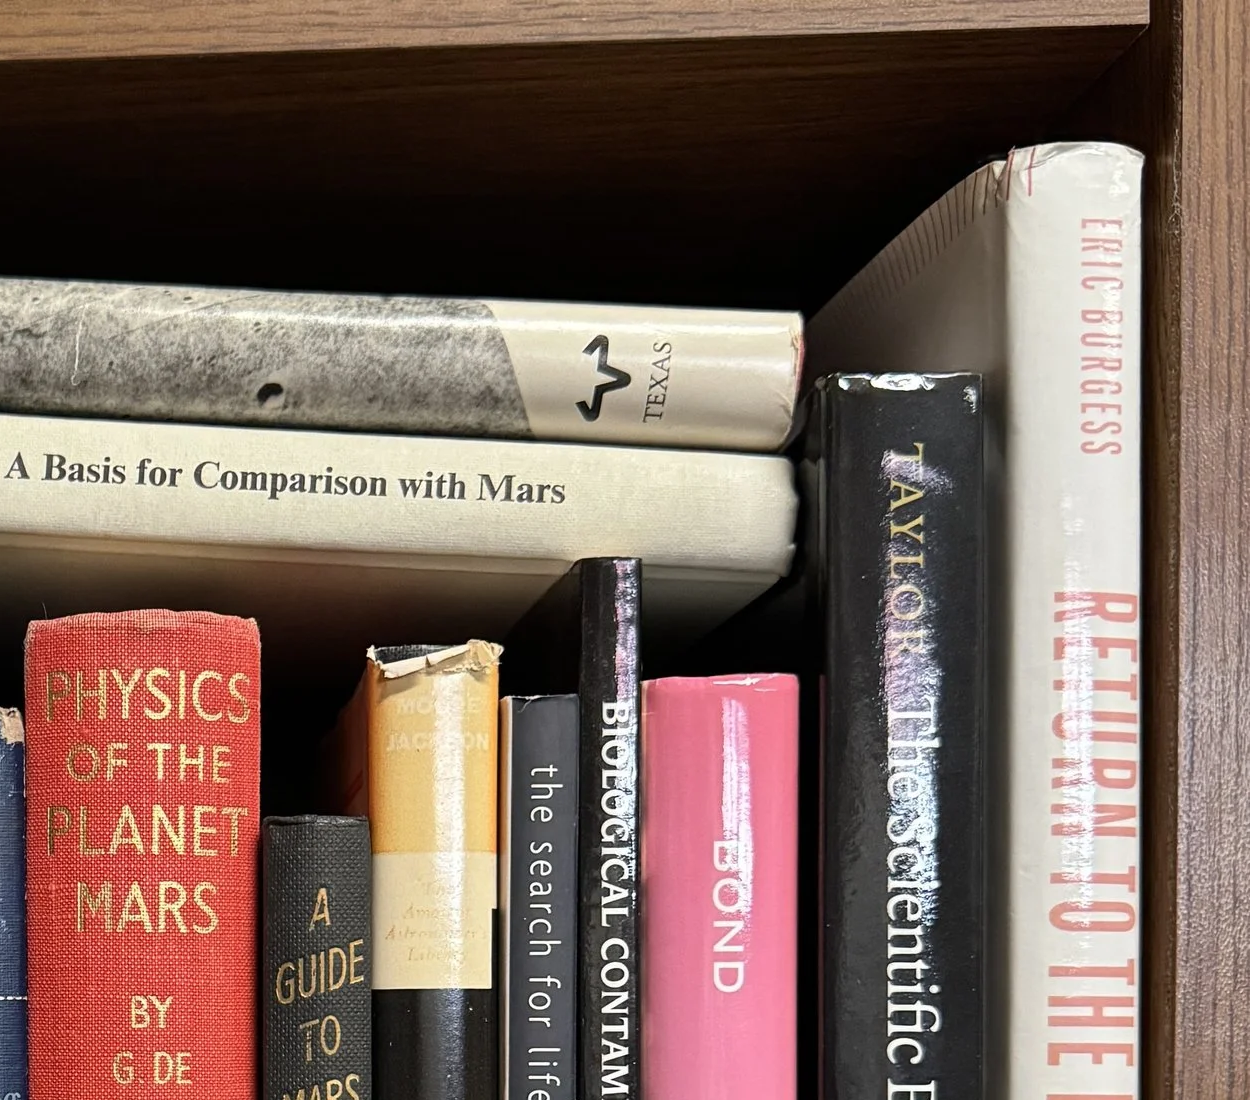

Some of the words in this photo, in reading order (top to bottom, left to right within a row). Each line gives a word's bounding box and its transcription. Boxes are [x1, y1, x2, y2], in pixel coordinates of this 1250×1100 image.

[1081, 217, 1122, 290] ERIC
[643, 342, 673, 422] TEXAS
[1080, 308, 1122, 456] BURGESS
[4, 453, 31, 483] A
[41, 454, 126, 489] Basis
[134, 458, 184, 491] for
[192, 460, 389, 503] Comparison
[397, 467, 467, 503] with
[475, 474, 567, 507] Mars
[888, 442, 926, 660] TAYLOR
[47, 667, 251, 724] PHYSICS
[1050, 591, 1138, 839] RETURN
[66, 743, 128, 782] OF
[147, 743, 231, 783] THE
[887, 696, 942, 800] The
[529, 765, 559, 824] the
[600, 699, 634, 926] BIOLOGICAL
[47, 806, 249, 857] PLANET
[76, 881, 219, 934] MARS
[309, 888, 331, 930] A
[529, 843, 561, 957] search
[712, 843, 745, 994] BOND
[1048, 867, 1135, 933] TO
[887, 812, 942, 1064] Scientific
[276, 938, 365, 1005] GUIDE
[530, 972, 560, 1029] for
[130, 995, 172, 1029] BY
[299, 1014, 342, 1063] TO
[1046, 958, 1134, 1067] THE
[113, 1051, 139, 1085] G.
[154, 1051, 193, 1085] DE
